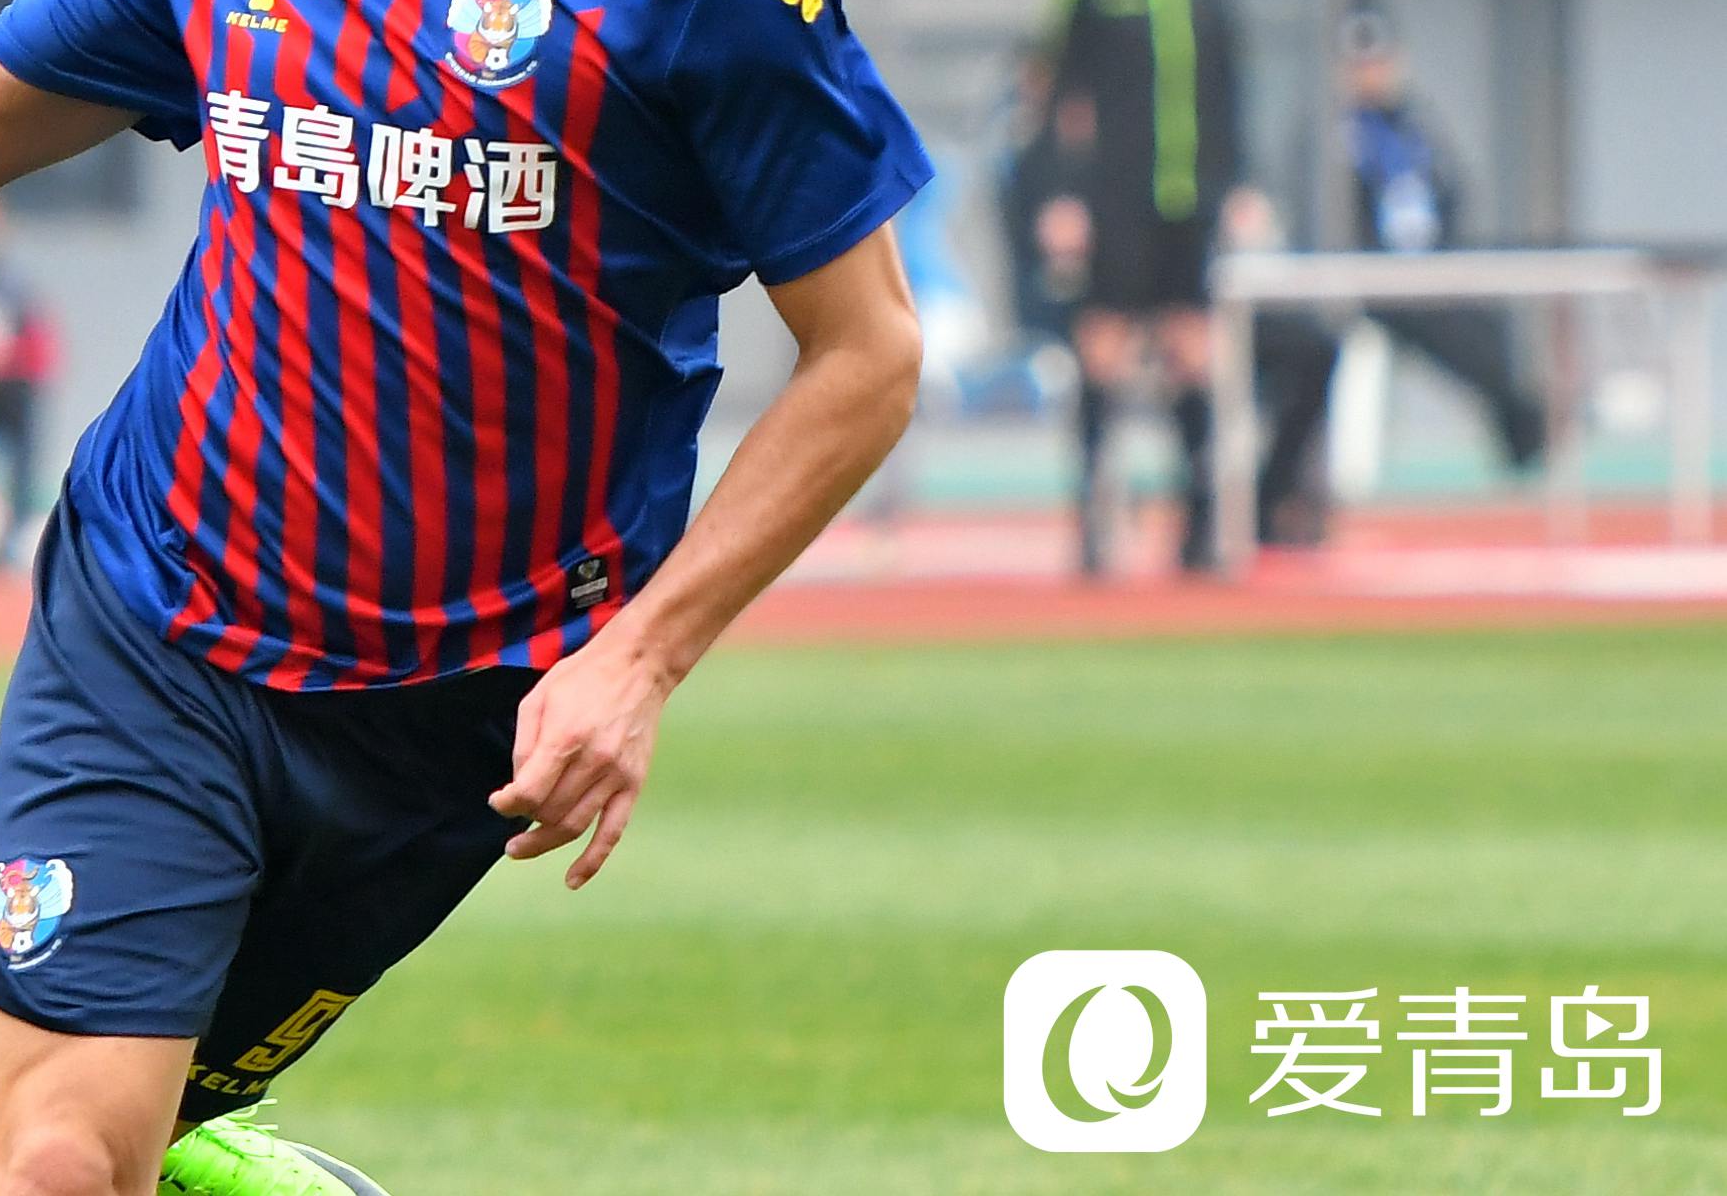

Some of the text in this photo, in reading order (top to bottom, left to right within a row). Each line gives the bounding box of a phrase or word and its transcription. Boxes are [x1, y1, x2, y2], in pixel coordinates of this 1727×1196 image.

[225, 10, 289, 33] KELME
[206, 90, 557, 235] 青島啤酒
